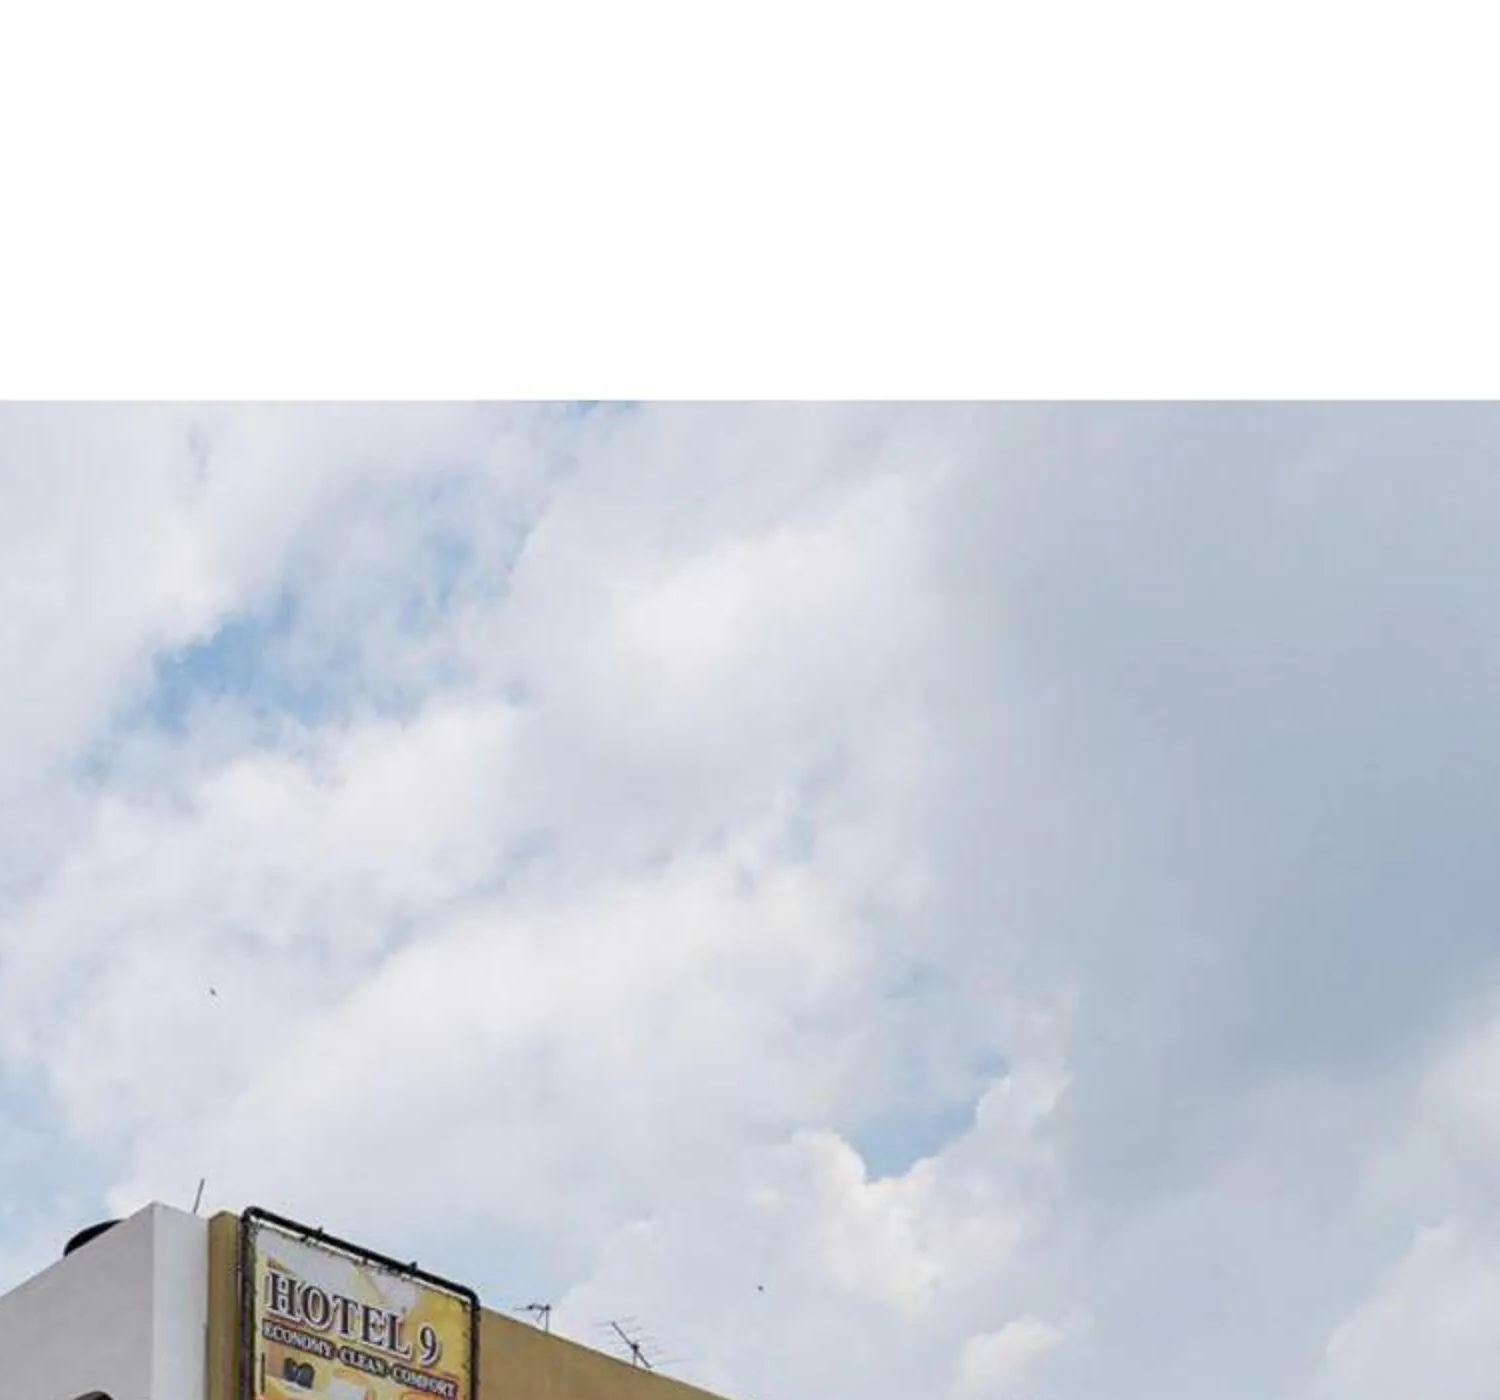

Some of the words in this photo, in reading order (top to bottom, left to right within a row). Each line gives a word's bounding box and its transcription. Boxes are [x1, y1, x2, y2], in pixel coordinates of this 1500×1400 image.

[263, 1323, 334, 1359] ECONOMY
[339, 1346, 387, 1377] CLEAN
[391, 1364, 458, 1398] COMFORT
[268, 1272, 412, 1361] HOTEL
[419, 1324, 440, 1366] 9
